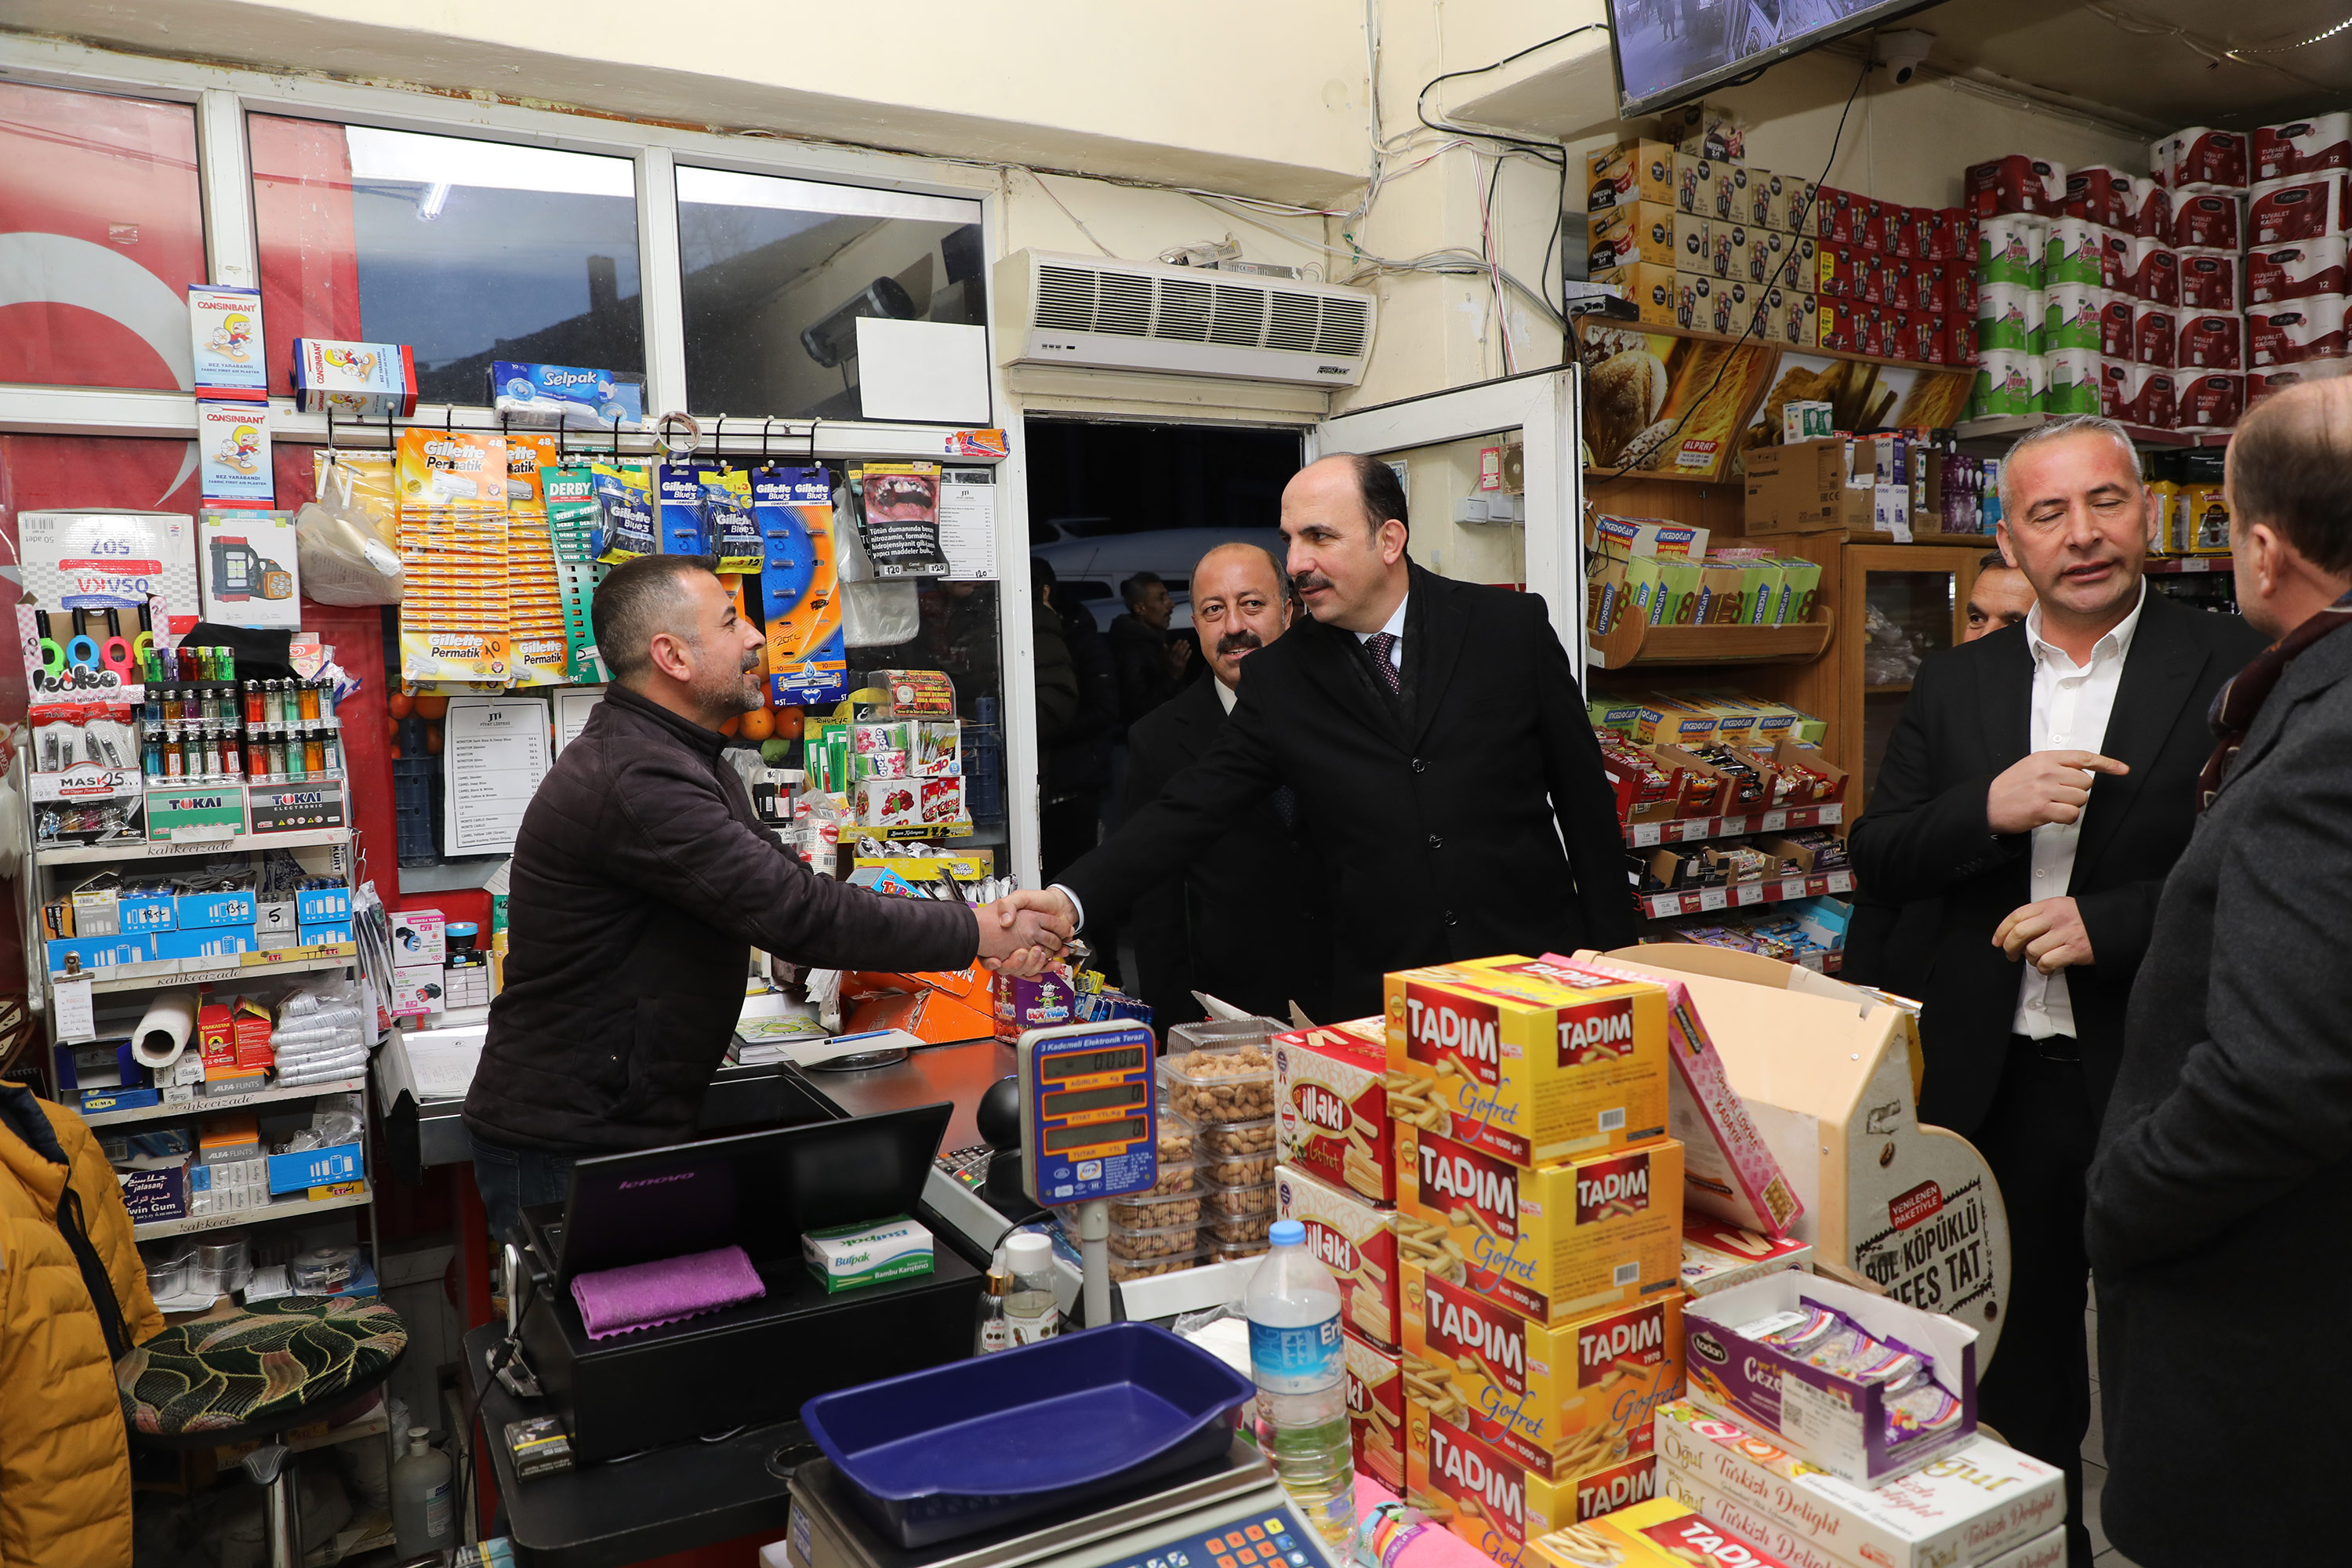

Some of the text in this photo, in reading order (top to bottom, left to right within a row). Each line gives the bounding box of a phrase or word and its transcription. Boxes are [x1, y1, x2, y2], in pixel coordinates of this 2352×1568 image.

[198, 301, 256, 312] CANSINBANT
[543, 371, 597, 387] Selpak
[207, 413, 265, 424] CANSINBANT
[488, 438, 503, 448] 48
[538, 437, 552, 446] 48
[1684, 441, 1715, 451] ALPRAF
[423, 441, 485, 459] Gillette
[550, 482, 591, 495] DERBY
[756, 484, 791, 494] Gillette
[795, 484, 829, 494] Gillette
[610, 506, 651, 524] Gillette
[869, 526, 887, 535] Tütün
[428, 633, 484, 647] Gillette
[518, 641, 563, 654] Gillette
[431, 648, 480, 659] Permatik
[524, 653, 562, 665] Permatik
[169, 797, 223, 810] TOKAI
[271, 792, 321, 805] TOKAI
[269, 908, 281, 923] 5
[1406, 998, 1497, 1065] TADIM
[1558, 1013, 1632, 1051] TADIM
[1047, 1041, 1083, 1051] Kademeli
[1083, 1037, 1121, 1047] Elektronik
[236, 1081, 260, 1090] FLINTS
[1458, 1077, 1519, 1143] Gofret
[1419, 1144, 1515, 1220] TADIM
[1577, 1168, 1647, 1208] TADIM
[151, 1203, 176, 1212] Gum
[1894, 1196, 1938, 1226] PAKETİYLE
[1497, 1221, 1514, 1236] 1978
[1903, 1198, 1978, 1272] KÖPÜKLÜ
[1473, 1232, 1537, 1294] Gofret
[1945, 1240, 1980, 1292] TAT
[875, 1269, 898, 1279] Bambu
[1426, 1289, 1523, 1376] TADIM
[1579, 1316, 1662, 1367] TADIM
[1643, 1352, 1661, 1364] 1978
[1504, 1374, 1523, 1392] 1978
[1479, 1385, 1544, 1443] Gofret
[1430, 1428, 1523, 1525] TADIM
[1715, 1452, 1768, 1499] Turkish
[1776, 1486, 1842, 1537] Delight
[1715, 1497, 1769, 1545] Turkish
[1505, 1522, 1522, 1539] 1978
